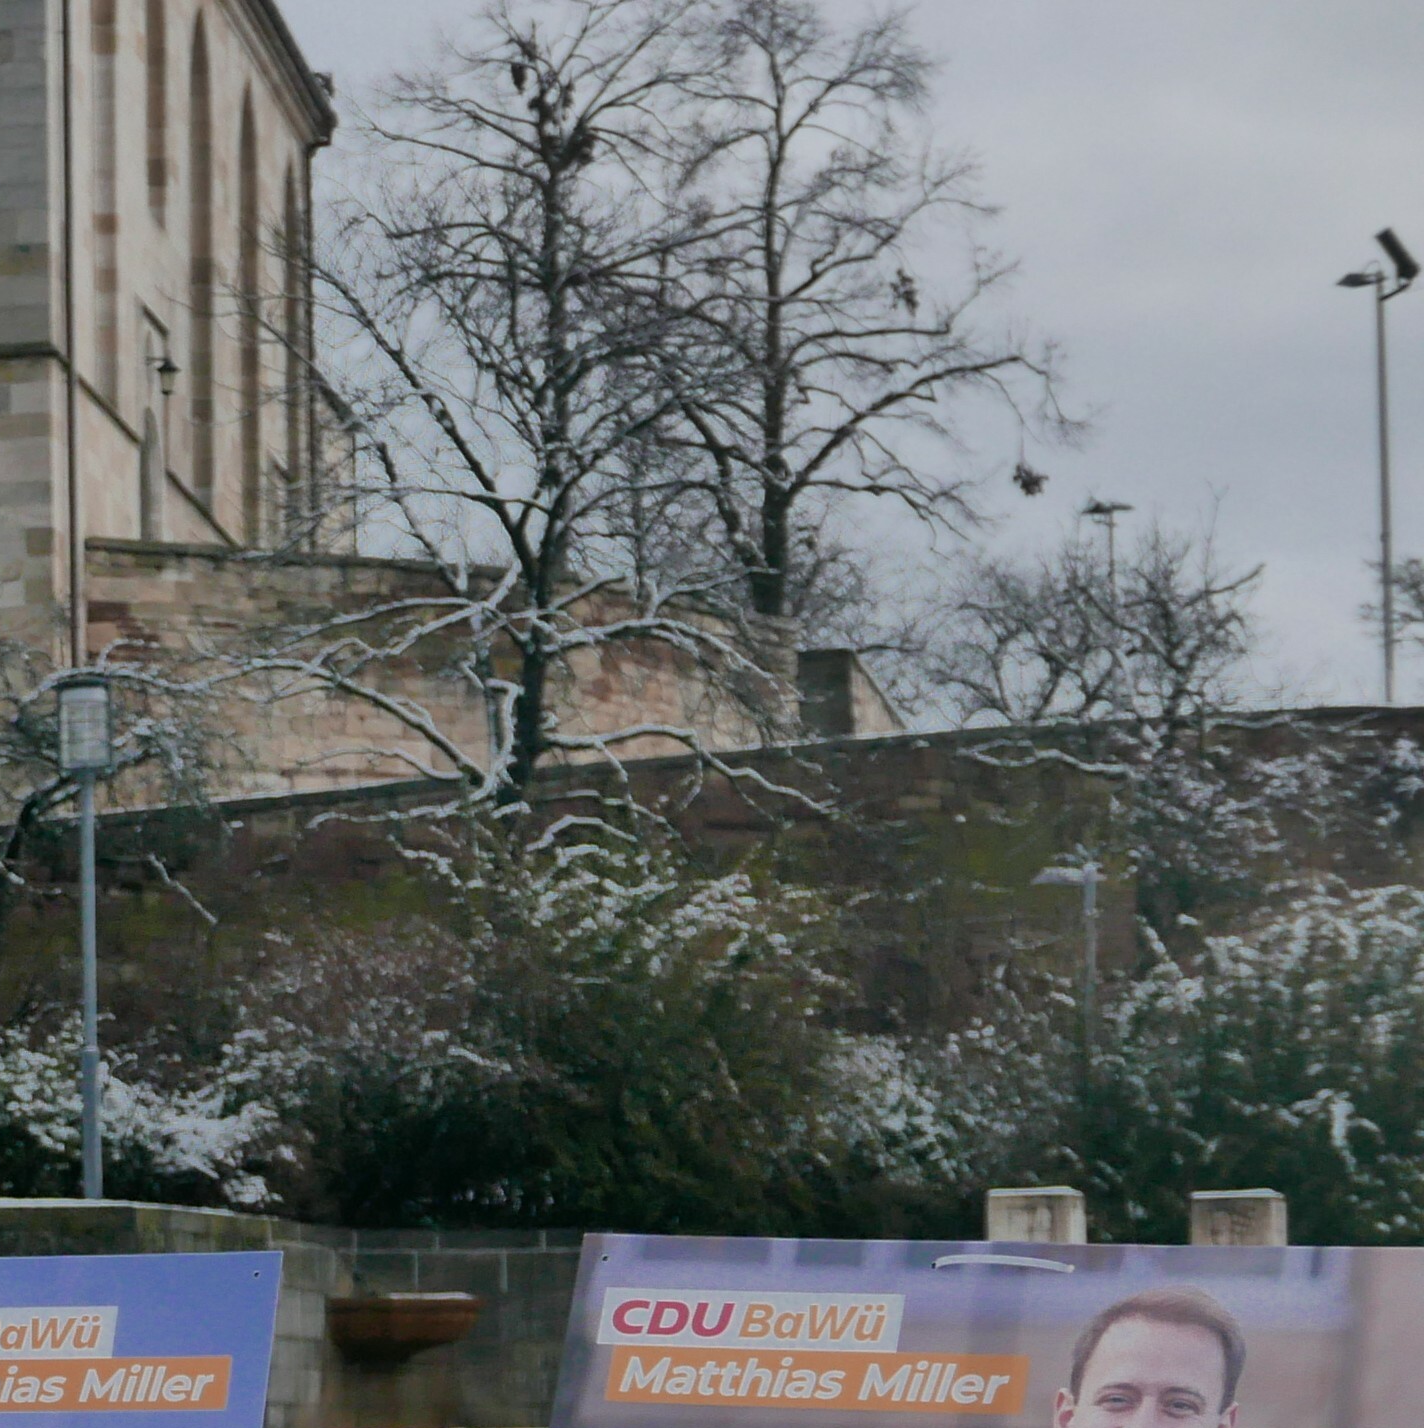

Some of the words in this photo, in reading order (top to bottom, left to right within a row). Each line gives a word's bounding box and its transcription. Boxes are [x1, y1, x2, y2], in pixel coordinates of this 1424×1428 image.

[612, 1299, 735, 1337] CDU
[738, 1303, 886, 1342] BaWü
[78, 1365, 214, 1402] Miller
[619, 1356, 845, 1400] Matthias
[858, 1362, 1009, 1405] Miller
